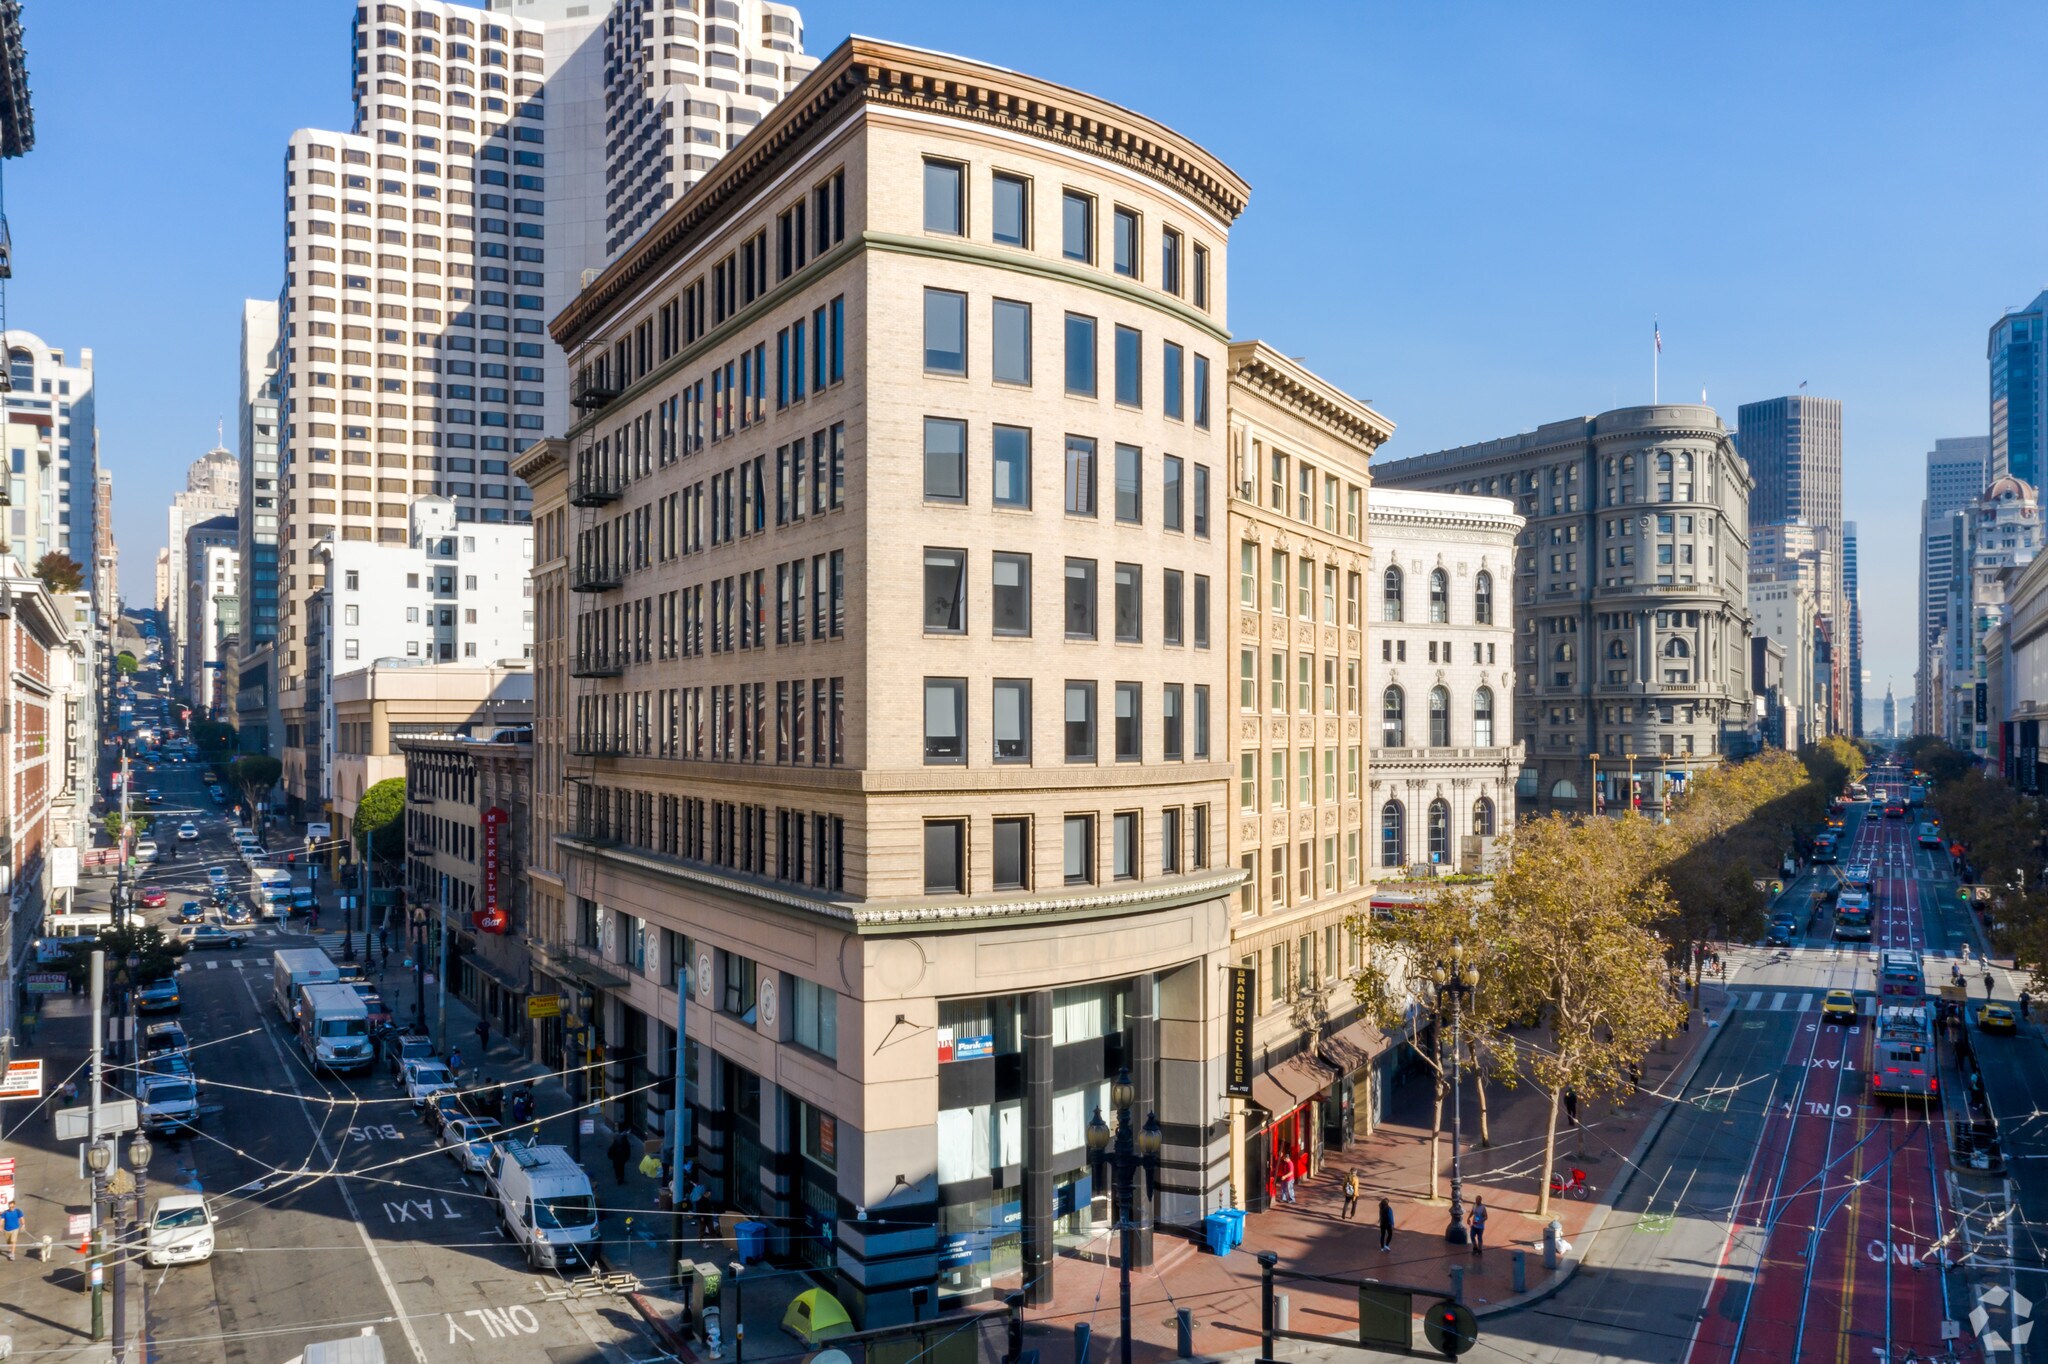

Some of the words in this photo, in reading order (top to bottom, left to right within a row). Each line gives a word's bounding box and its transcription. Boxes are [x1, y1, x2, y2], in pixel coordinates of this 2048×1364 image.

[66, 703, 77, 795] HOTEL
[487, 814, 496, 915] MIKKELLER
[481, 917, 502, 928] Bar
[1236, 970, 1246, 1024] BRANDON
[1805, 1024, 1861, 1034] BUS
[1234, 1029, 1244, 1083] COLLEGE
[1802, 1058, 1856, 1071] TAXI
[1781, 1101, 1852, 1118] ONLY
[348, 1124, 400, 1141] BUS
[382, 1198, 462, 1223] TAXI
[1004, 1211, 1022, 1223] CBRE
[444, 1304, 540, 1345] ONLY
